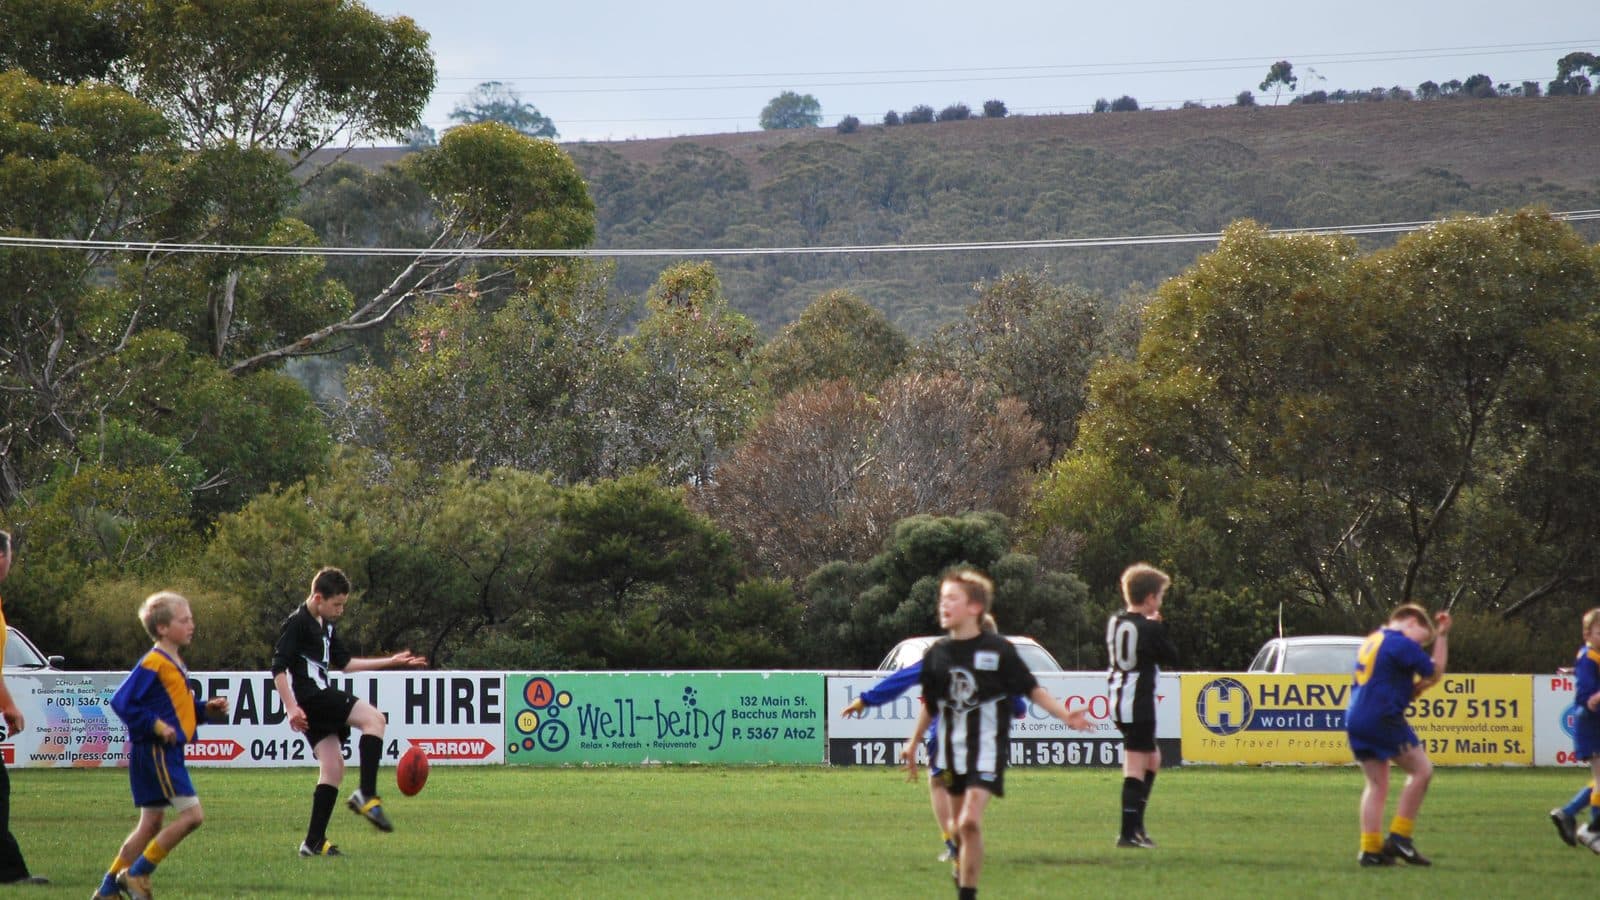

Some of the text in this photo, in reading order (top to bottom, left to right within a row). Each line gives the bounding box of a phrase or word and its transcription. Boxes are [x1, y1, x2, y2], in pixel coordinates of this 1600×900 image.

[534, 684, 546, 701] A
[1444, 680, 1475, 694] Call
[405, 678, 500, 724] HIRE
[740, 696, 808, 706] 132 Main St.
[1259, 684, 1352, 706] HARV
[47, 698, 53, 706] P
[56, 698, 75, 707] (03)
[78, 698, 100, 706] 5367
[1467, 699, 1519, 718] 5151
[732, 709, 816, 719] Bacchus Marsh
[1261, 714, 1348, 728] world tr
[523, 717, 532, 727] to
[577, 698, 726, 750] Well-being
[1029, 723, 1047, 731] COPY
[1050, 723, 1073, 731] CENT
[44, 735, 125, 745] P (03) 9747 9944
[548, 726, 558, 743] Z
[732, 727, 815, 739] P. 5367 AtoZ
[184, 743, 234, 756] RROW
[251, 739, 305, 760] 0412
[653, 741, 697, 750] Rejuvenate
[1201, 739, 1226, 748] The
[1235, 739, 1279, 748] Travel
[1455, 738, 1497, 753] Main
[1504, 739, 1526, 753] St.
[852, 742, 886, 764] 112
